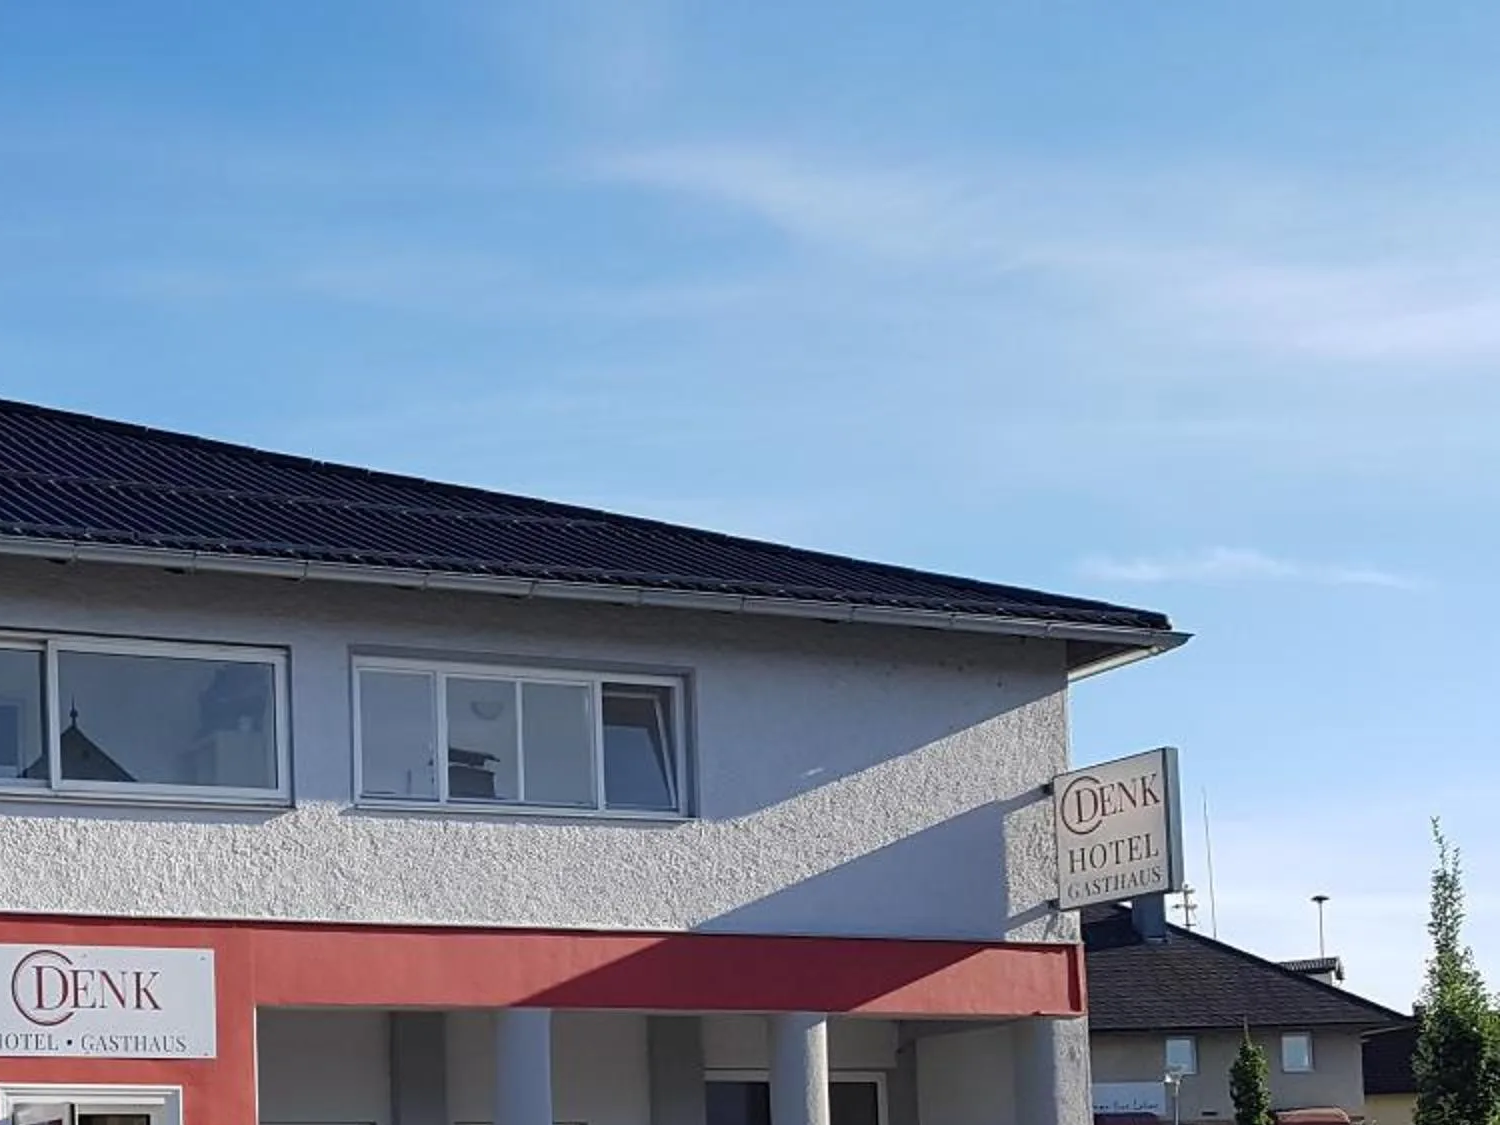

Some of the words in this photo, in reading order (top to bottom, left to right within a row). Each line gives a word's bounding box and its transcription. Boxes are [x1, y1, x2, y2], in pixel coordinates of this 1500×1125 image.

[1075, 773, 1161, 825] DENK
[1069, 833, 1160, 874] HOTEL
[1067, 865, 1162, 900] GASTHAUS
[31, 965, 163, 1011] DENK
[80, 1034, 188, 1053] GASTHAUS
